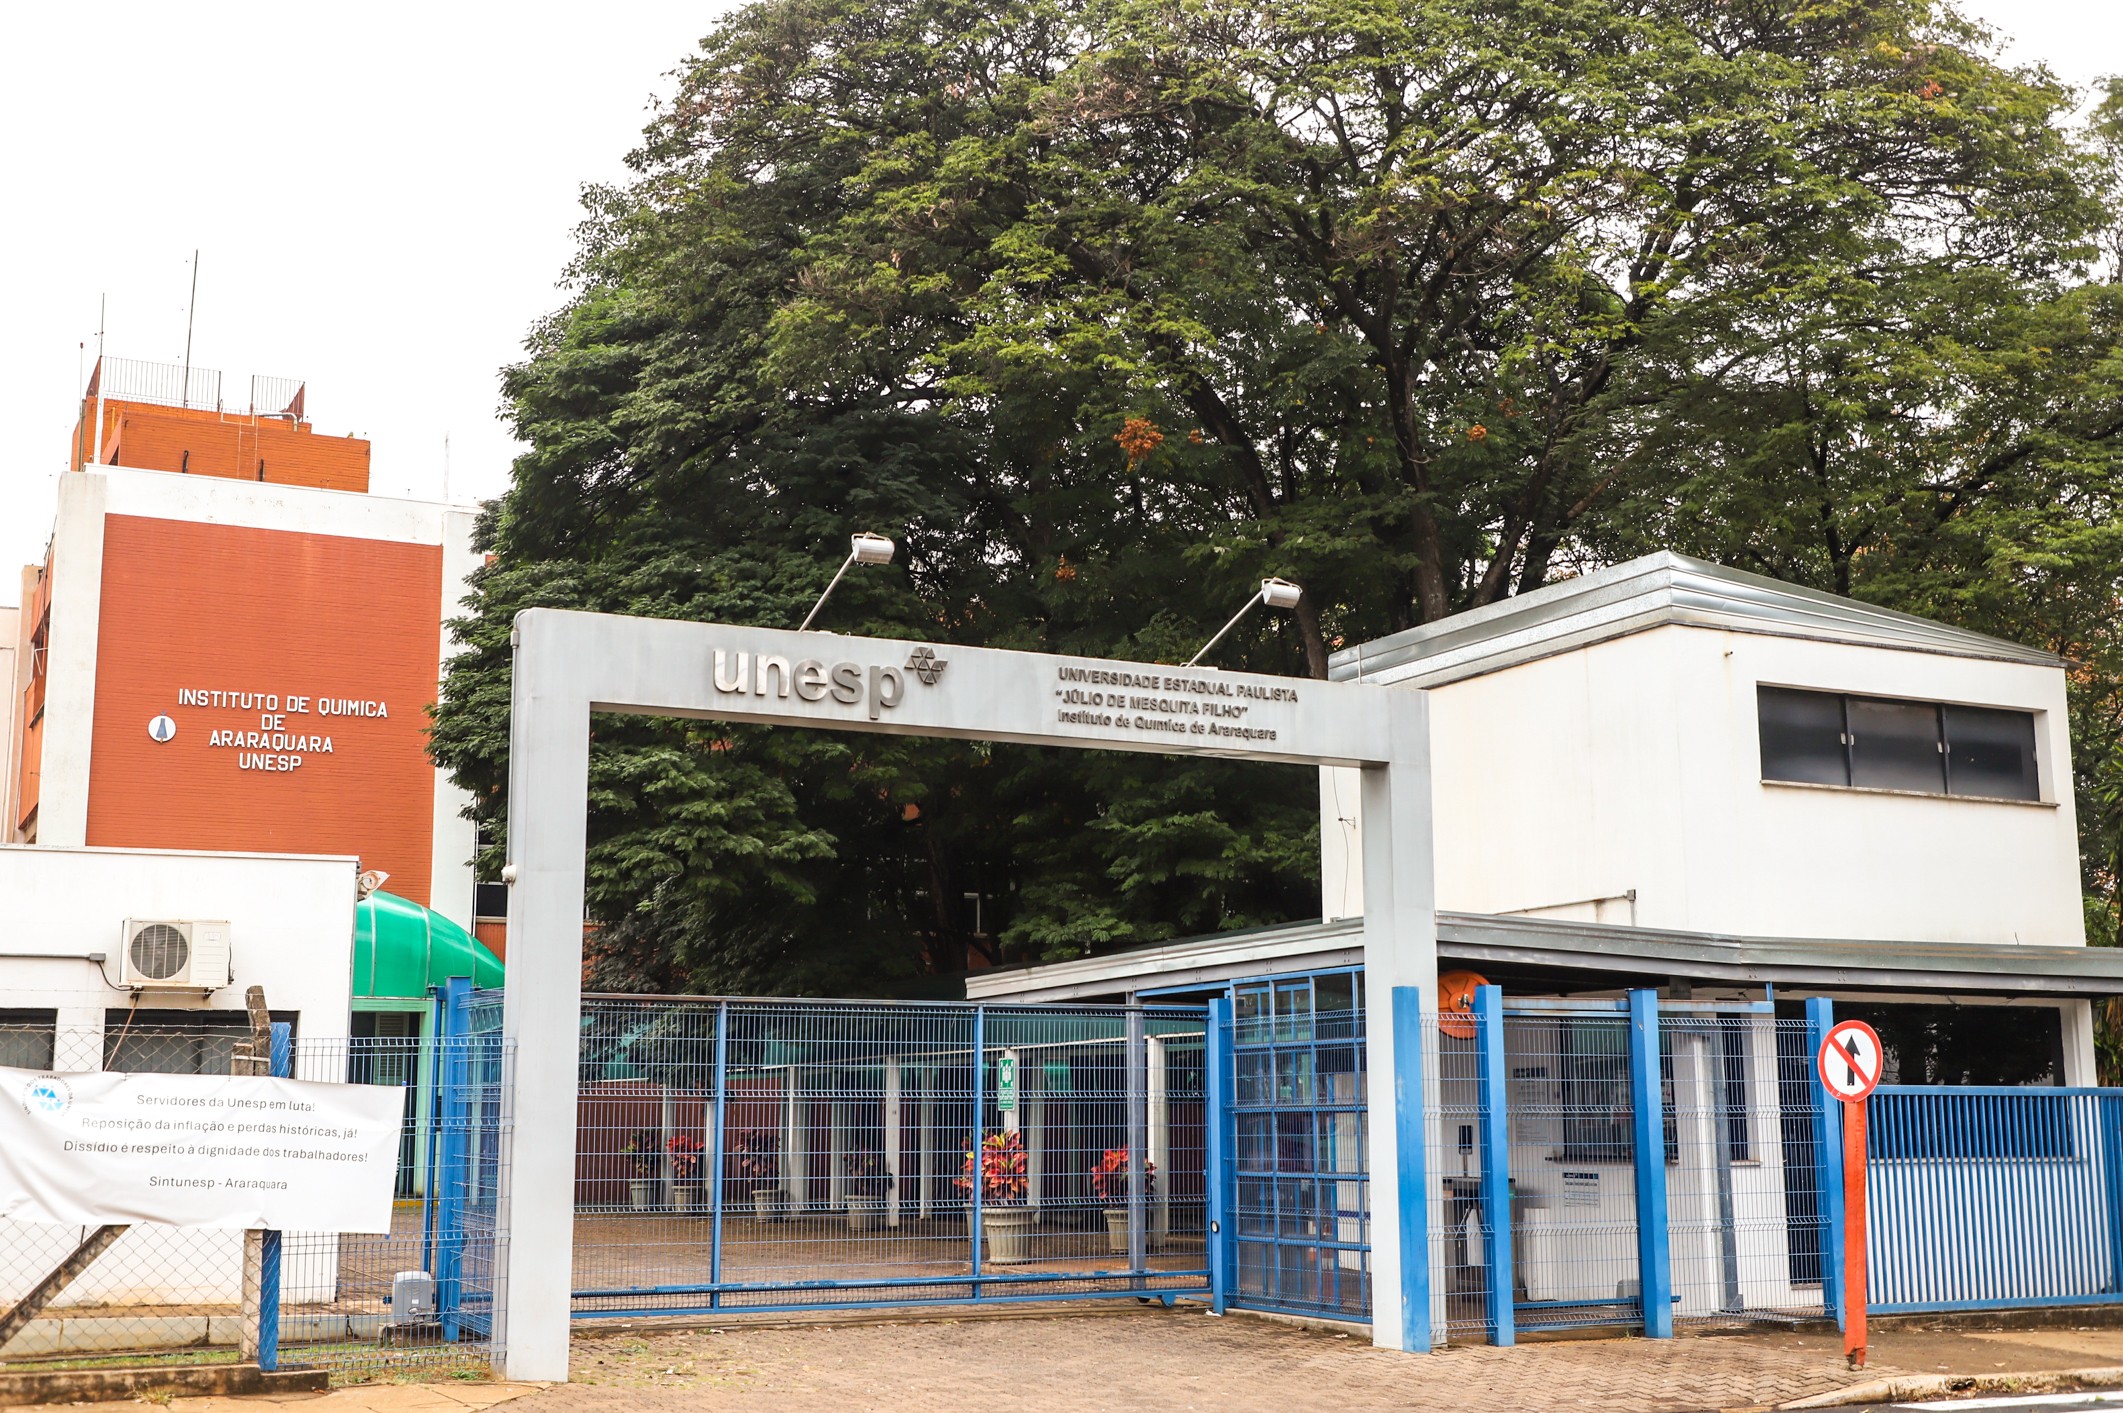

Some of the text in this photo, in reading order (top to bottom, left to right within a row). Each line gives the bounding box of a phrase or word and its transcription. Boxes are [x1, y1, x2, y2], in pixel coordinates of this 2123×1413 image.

[713, 648, 905, 720] unesp
[1058, 667, 1299, 702] UNIVERSIDADE ESTADUAL PAULISTA
[178, 688, 388, 718] INSTITUTO DE QUIMICA
[1106, 693, 1126, 708] DE
[1130, 695, 1199, 715] MESQUITA
[261, 714, 286, 731] DE
[1058, 708, 1112, 726] Instituto
[1114, 713, 1131, 728] de
[1189, 720, 1206, 735] de
[1208, 722, 1277, 741] Araraquara
[209, 730, 334, 753] ARARAQUARA
[239, 752, 302, 772] UNESP
[137, 1094, 315, 1112] Servidores da Unesp em luta!
[82, 1117, 358, 1140] Reposição da inflação e perdas históricas, já!
[63, 1140, 118, 1153] Dissídio
[131, 1143, 185, 1156] respeito
[187, 1144, 195, 1155] à
[197, 1145, 260, 1158] dignidade
[262, 1147, 280, 1158] dos
[283, 1148, 368, 1162] trabalhadores!
[149, 1176, 215, 1189] Sintunesp
[225, 1178, 288, 1190] Araraquara
